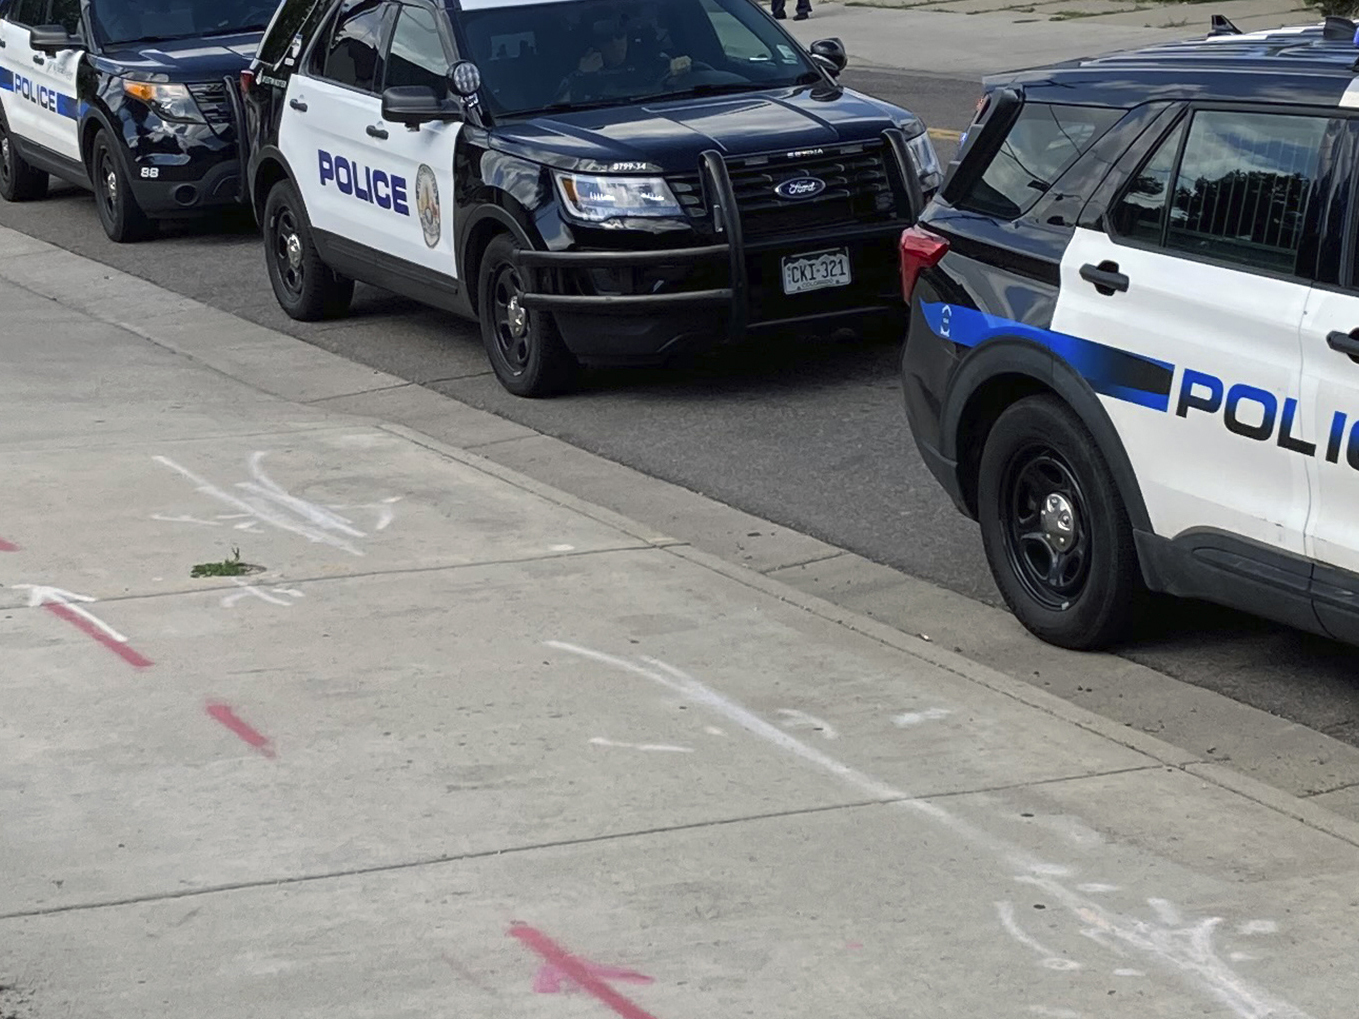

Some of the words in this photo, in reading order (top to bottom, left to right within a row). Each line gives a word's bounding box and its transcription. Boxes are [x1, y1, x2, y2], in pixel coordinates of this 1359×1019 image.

[14, 74, 57, 113] POLICE
[140, 167, 159, 178] 88
[318, 148, 410, 217] POLICE
[788, 180, 816, 195] Ford
